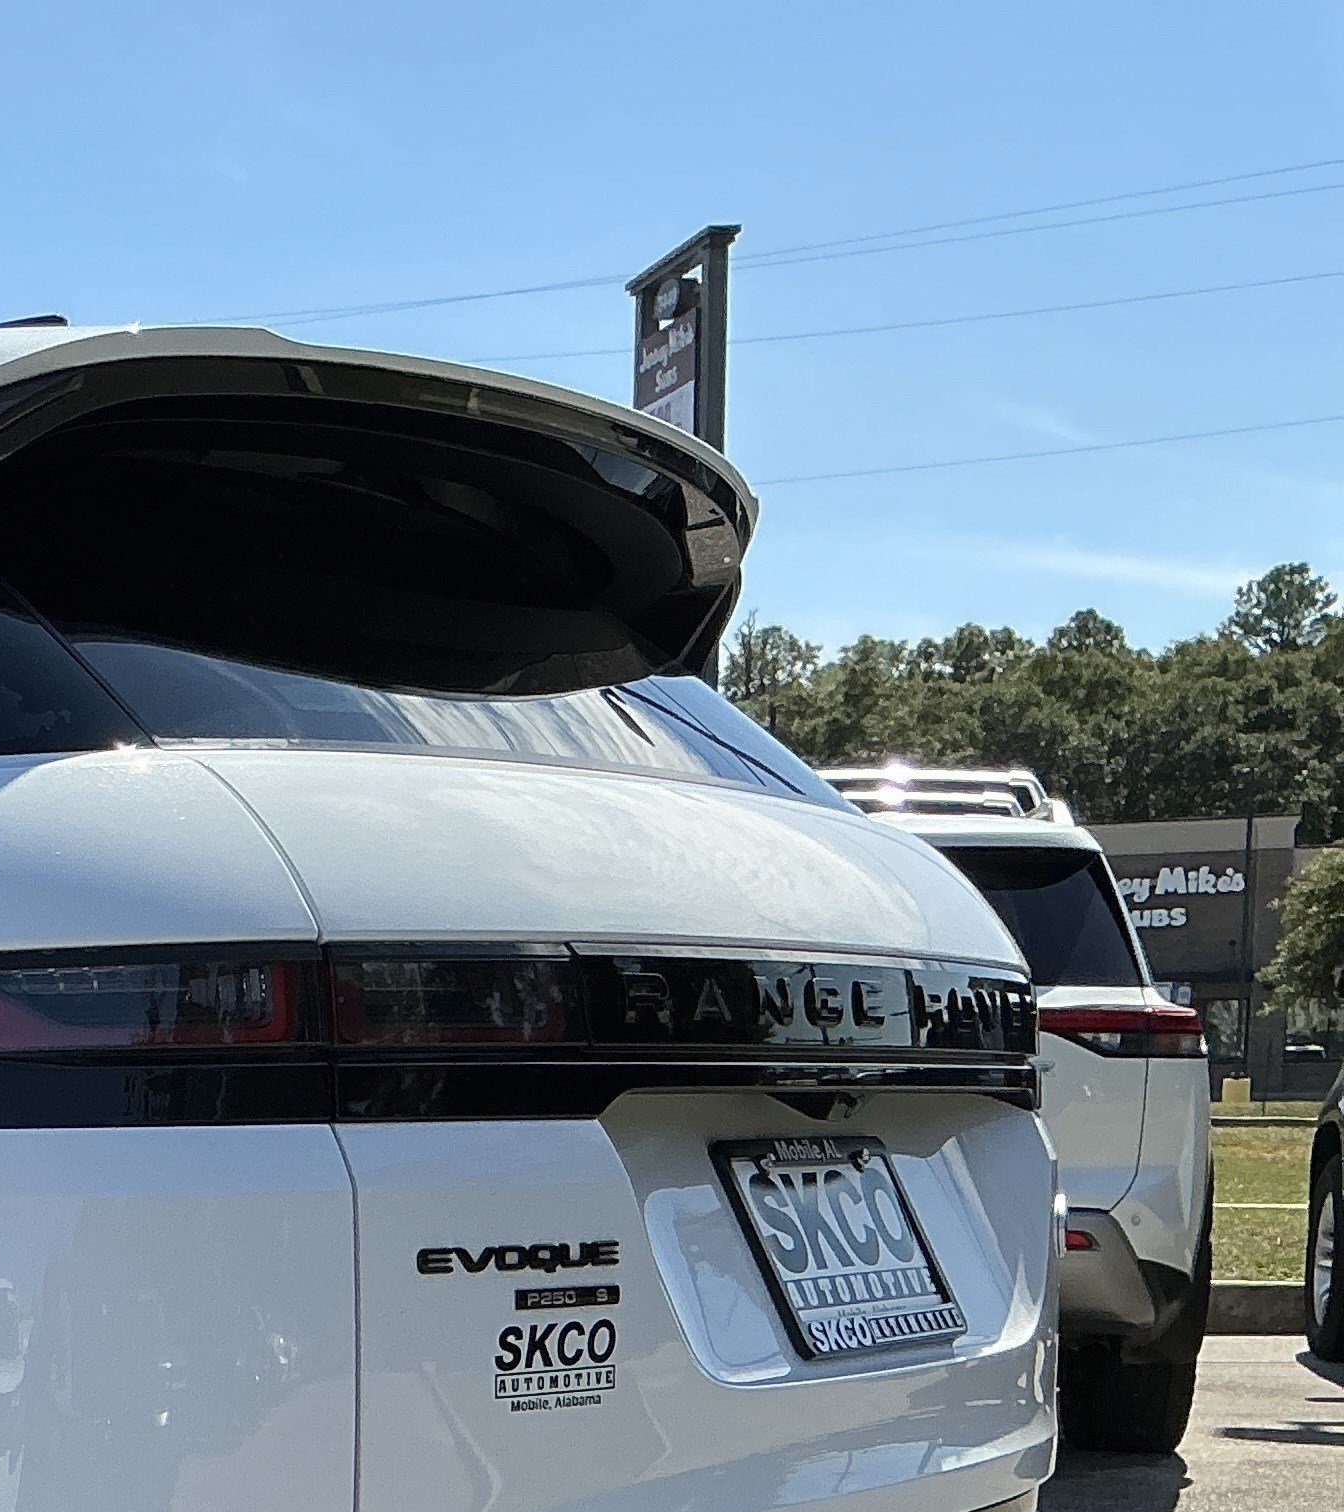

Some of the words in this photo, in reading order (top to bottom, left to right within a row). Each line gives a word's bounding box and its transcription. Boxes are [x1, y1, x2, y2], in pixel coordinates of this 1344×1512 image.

[1116, 878, 1151, 903] ey
[1154, 865, 1245, 894] Mike's
[1130, 907, 1187, 927] UBS
[623, 970, 888, 1030] RANGE
[913, 983, 1032, 1034] ROVE
[749, 1168, 915, 1274] SKCO
[417, 1240, 619, 1274] EVOQUE
[527, 1290, 577, 1307] P250
[787, 1268, 937, 1308] AUTOMOTIVE
[495, 1318, 616, 1371] SKCO
[810, 1316, 875, 1352] SKCO
[498, 1370, 613, 1394] AUTOMOTIVE
[511, 1399, 552, 1412] Mobile,
[554, 1394, 602, 1409] Alabama
